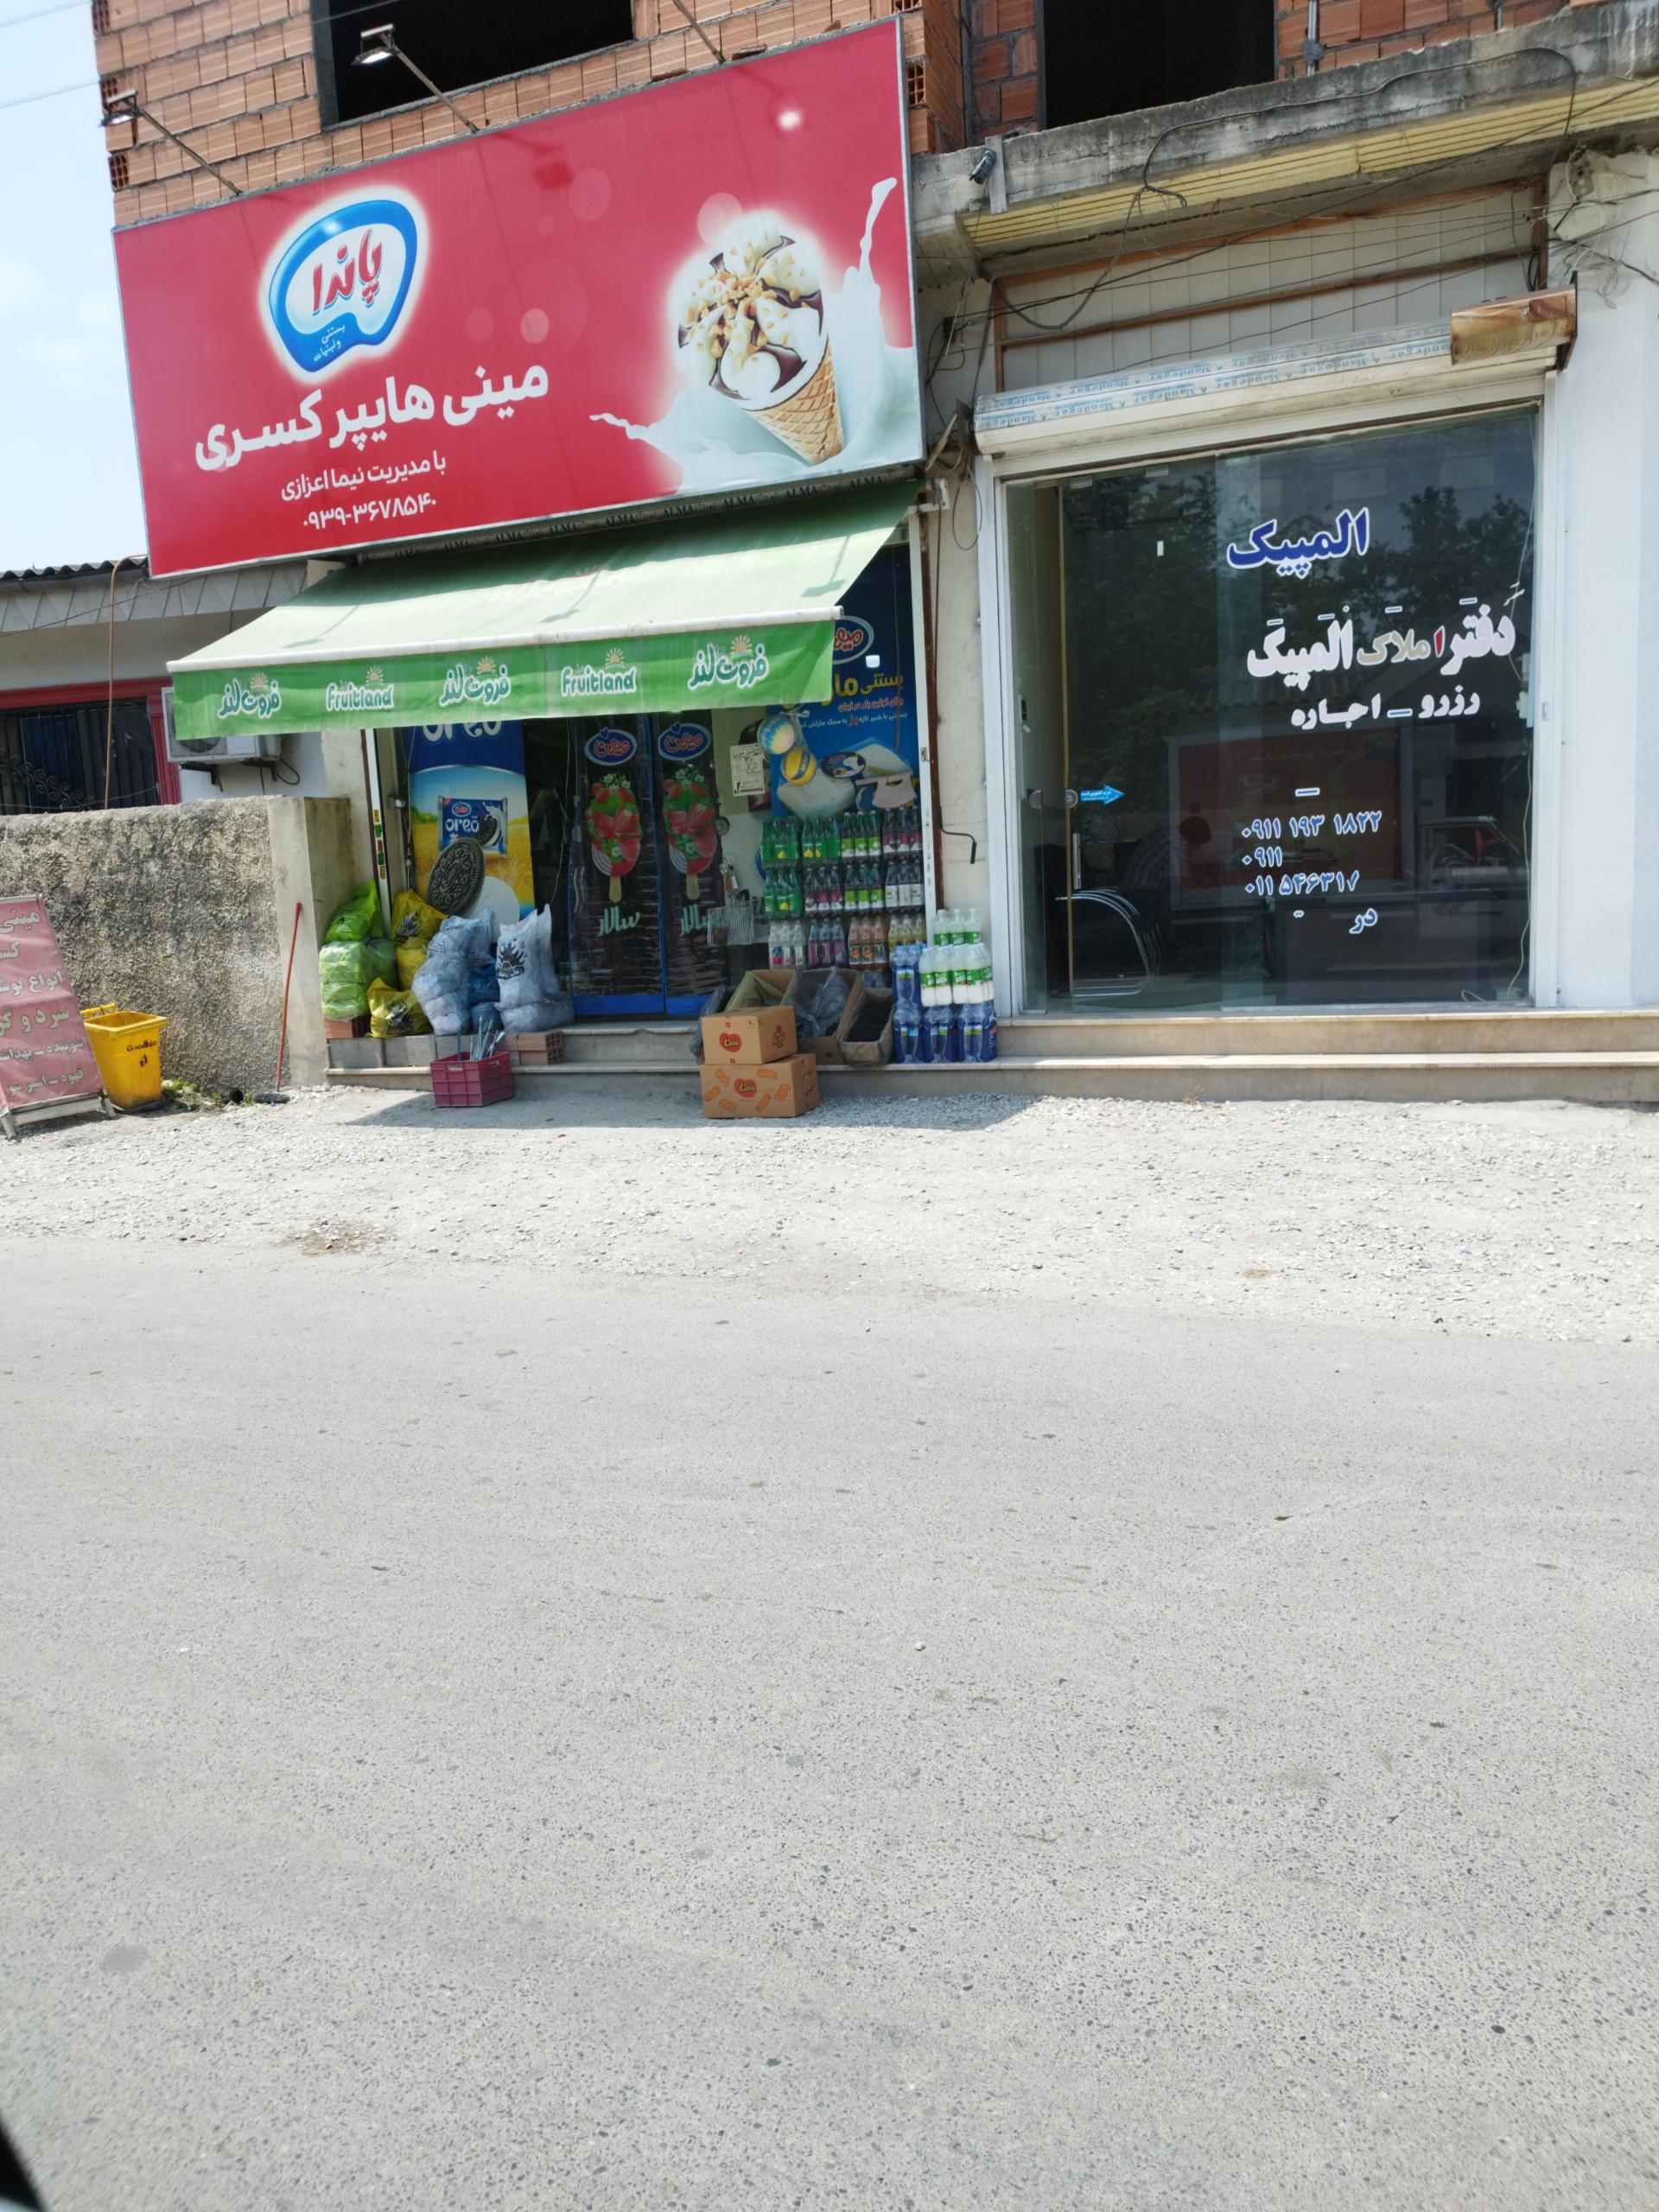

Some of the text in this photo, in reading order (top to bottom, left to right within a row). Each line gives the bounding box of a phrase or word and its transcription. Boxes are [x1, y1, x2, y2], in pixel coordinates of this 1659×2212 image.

[313, 227, 383, 314] پاندا
[322, 324, 346, 344] بستنی
[1389, 341, 1450, 359] andegar
[1149, 364, 1211, 381] Mandegar
[1216, 371, 1280, 389] Mandegar
[995, 391, 1052, 409] Mandegar
[1070, 378, 1129, 395] Mandegar
[1133, 388, 1196, 404] Mandegar
[195, 364, 550, 471] مینی هایپر کسری
[1054, 400, 1115, 416] Mandegar
[281, 448, 447, 502] با مدیریت نیما اعزازی
[302, 492, 437, 530] ۰۹۳۹-۳۶۷۸۵۴۰
[549, 523, 579, 536] ALMA
[1227, 507, 1370, 579] المپیک
[1357, 626, 1446, 666] املاک
[562, 664, 637, 696] Fruitland
[688, 643, 769, 690] فروت لند
[326, 682, 395, 712] Fruitland
[438, 664, 512, 708] فروت لند
[861, 673, 904, 695] بستنی
[218, 678, 283, 720] فروت لند
[1291, 693, 1381, 729] اجاره
[29, 969, 63, 993] انواع
[22, 1015, 31, 1033] و
